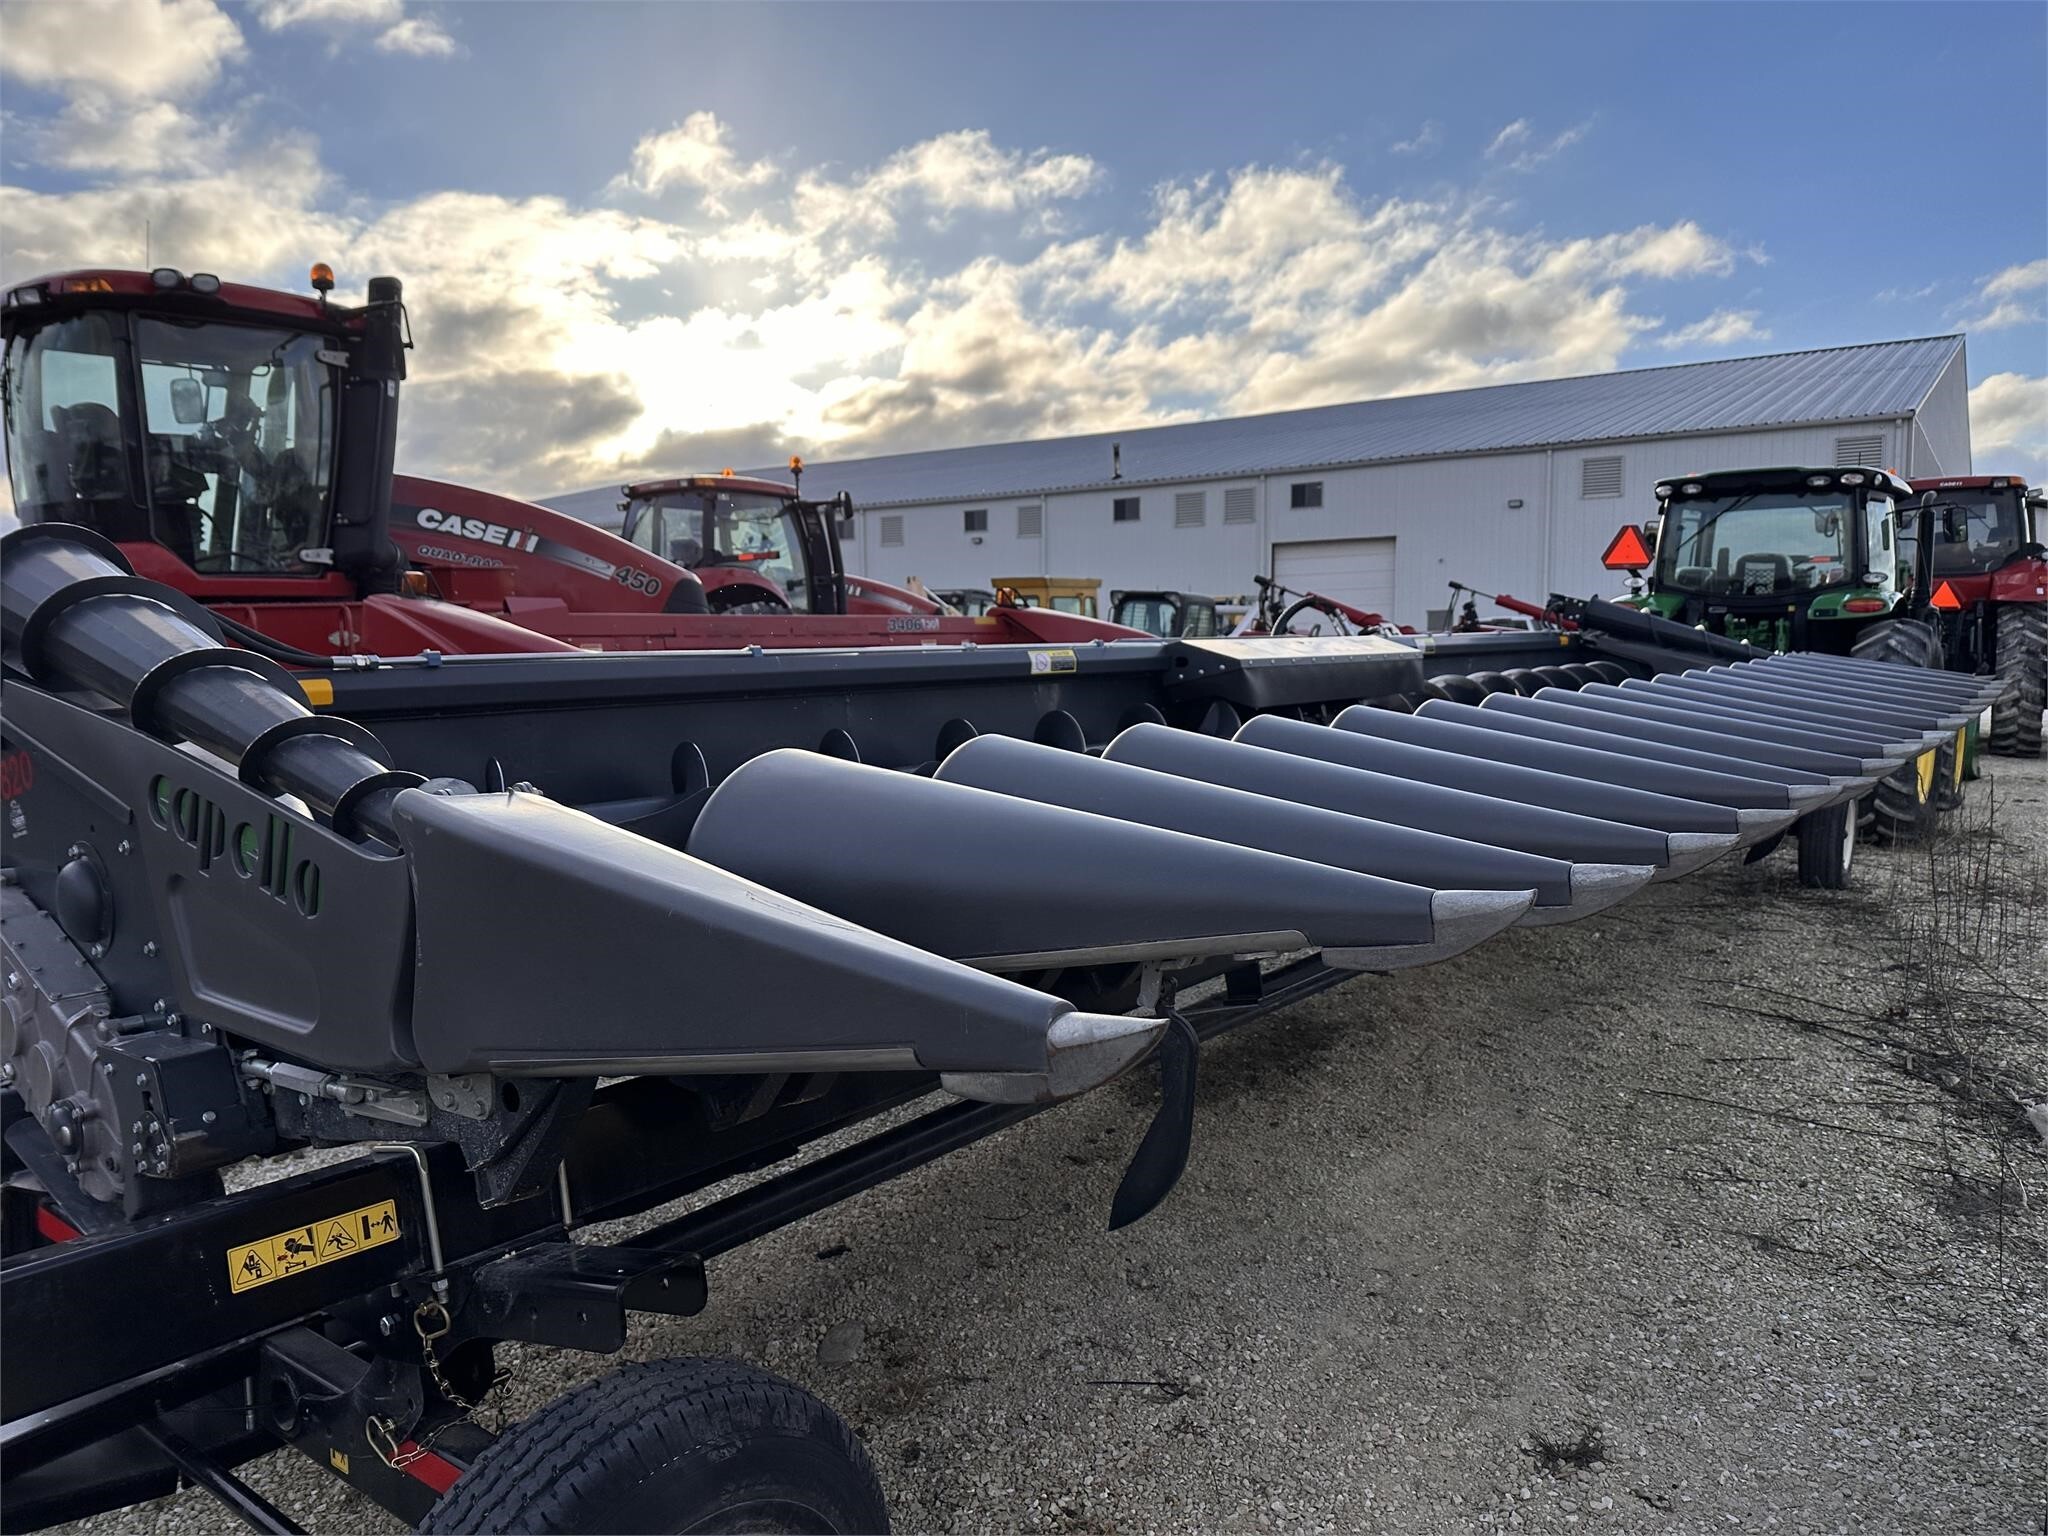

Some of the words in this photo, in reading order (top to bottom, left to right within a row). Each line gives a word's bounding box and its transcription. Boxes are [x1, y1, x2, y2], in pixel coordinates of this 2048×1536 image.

[416, 508, 508, 546] CASE
[614, 565, 662, 597] 450
[887, 616, 921, 632] 3406
[148, 774, 326, 920] capello
